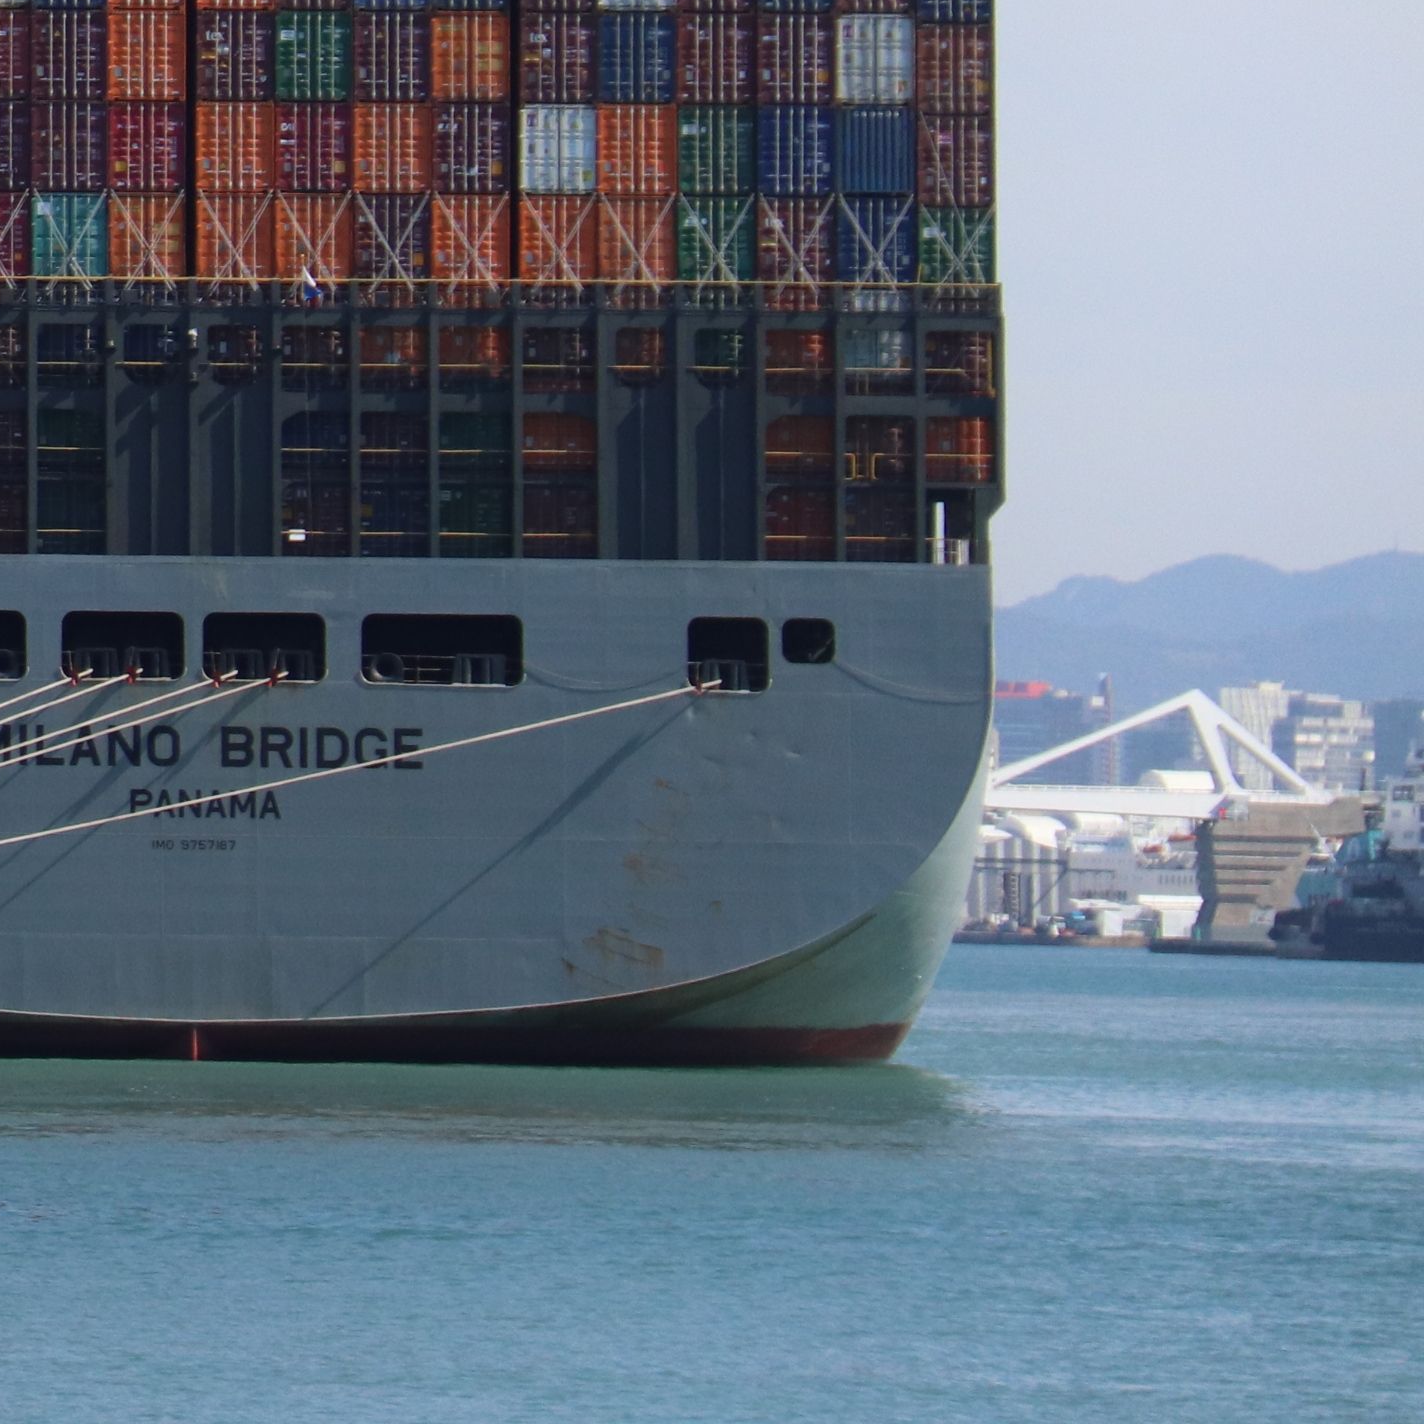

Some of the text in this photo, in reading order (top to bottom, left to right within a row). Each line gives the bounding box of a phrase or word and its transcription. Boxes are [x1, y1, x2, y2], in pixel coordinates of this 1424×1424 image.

[206, 30, 225, 41] tex
[220, 726, 424, 770] BRIDGE
[128, 788, 282, 819] PANAMA
[151, 840, 236, 851] IMO 9757187
